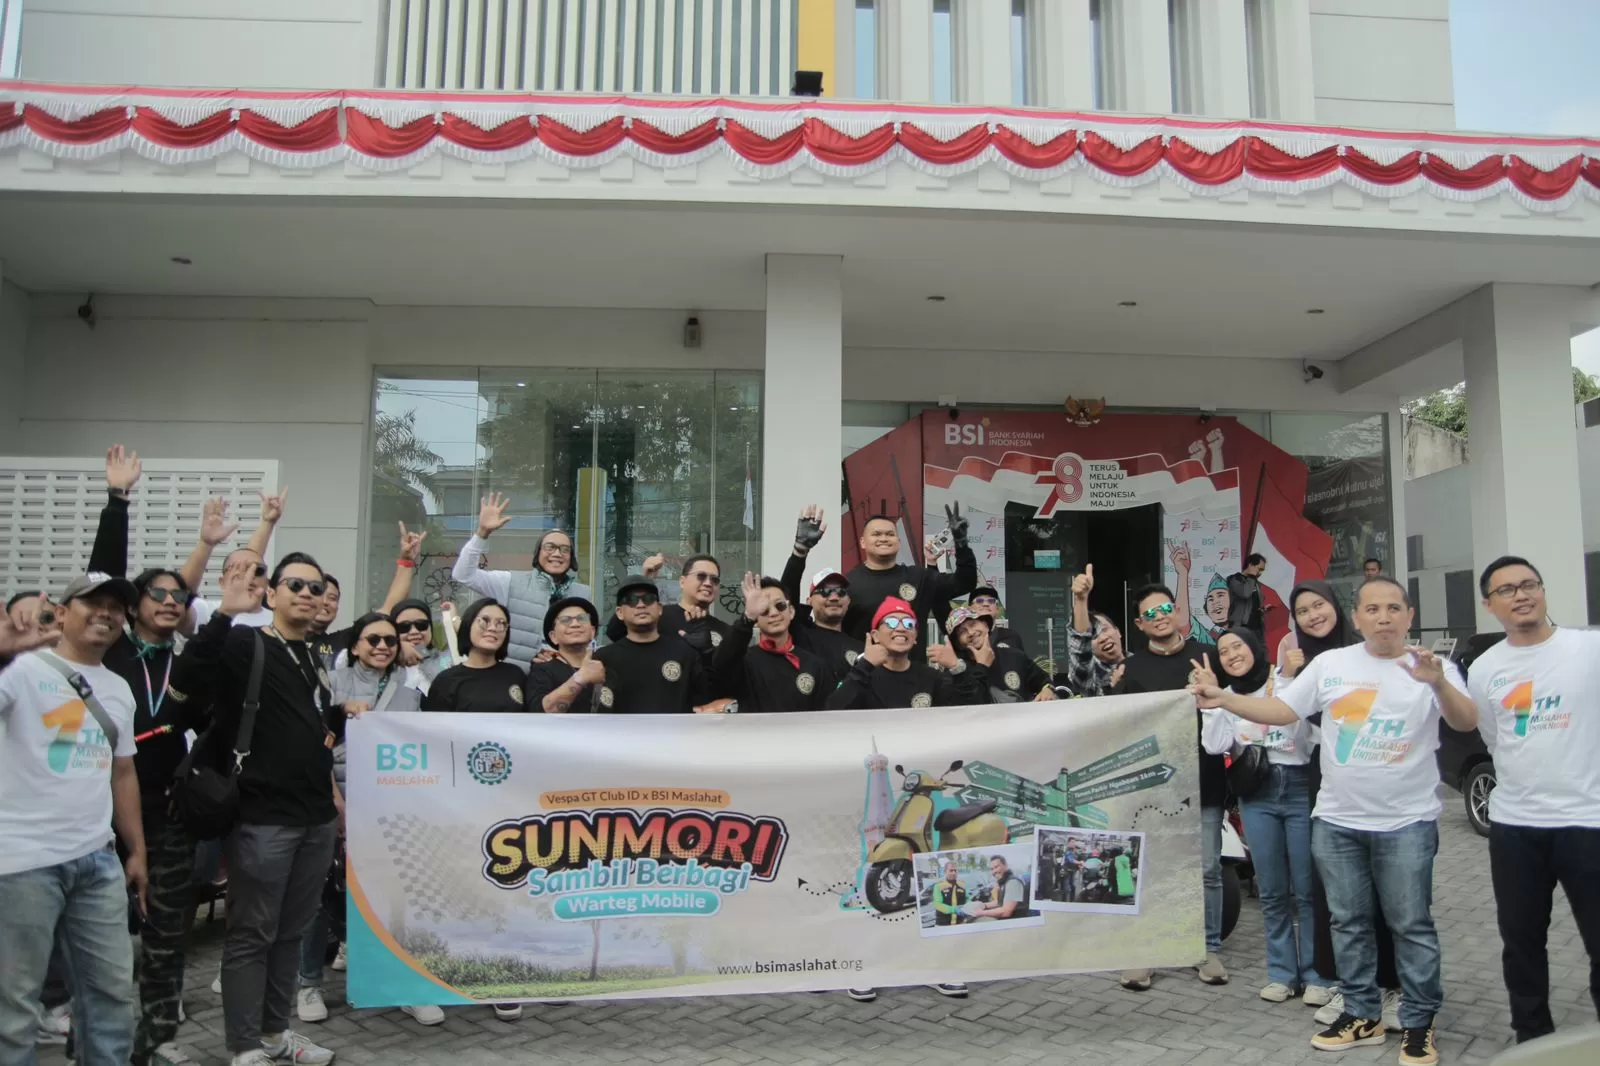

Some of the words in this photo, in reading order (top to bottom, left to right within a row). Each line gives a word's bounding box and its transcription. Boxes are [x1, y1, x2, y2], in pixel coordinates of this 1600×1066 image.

[944, 423, 984, 446] BSI
[989, 431, 1011, 440] BANK
[1012, 431, 1045, 441] SYARIAH
[989, 439, 1033, 447] INDONESIA
[1089, 464, 1117, 472] TERUS
[1089, 473, 1124, 481] MELAJU
[1034, 455, 1083, 516] 78
[1089, 482, 1119, 490] UNTUK
[1089, 491, 1136, 499] INDONESIA
[1534, 695, 1561, 710] TH
[376, 743, 428, 771] BSI
[376, 774, 440, 785] MASLAHAT
[547, 794, 580, 805] Vespa
[582, 791, 597, 802] GT
[600, 791, 625, 801] Club
[627, 791, 640, 801] ID
[643, 793, 649, 801] x
[651, 791, 669, 801] BSI
[672, 791, 722, 804] Maslahat
[490, 815, 774, 876] SUNMORI
[529, 860, 628, 896] Sambil
[636, 859, 752, 893] Berbagi
[566, 895, 638, 913] Warteg
[641, 893, 706, 910] Mobile
[717, 958, 864, 975] www.bsimaslahat.org
